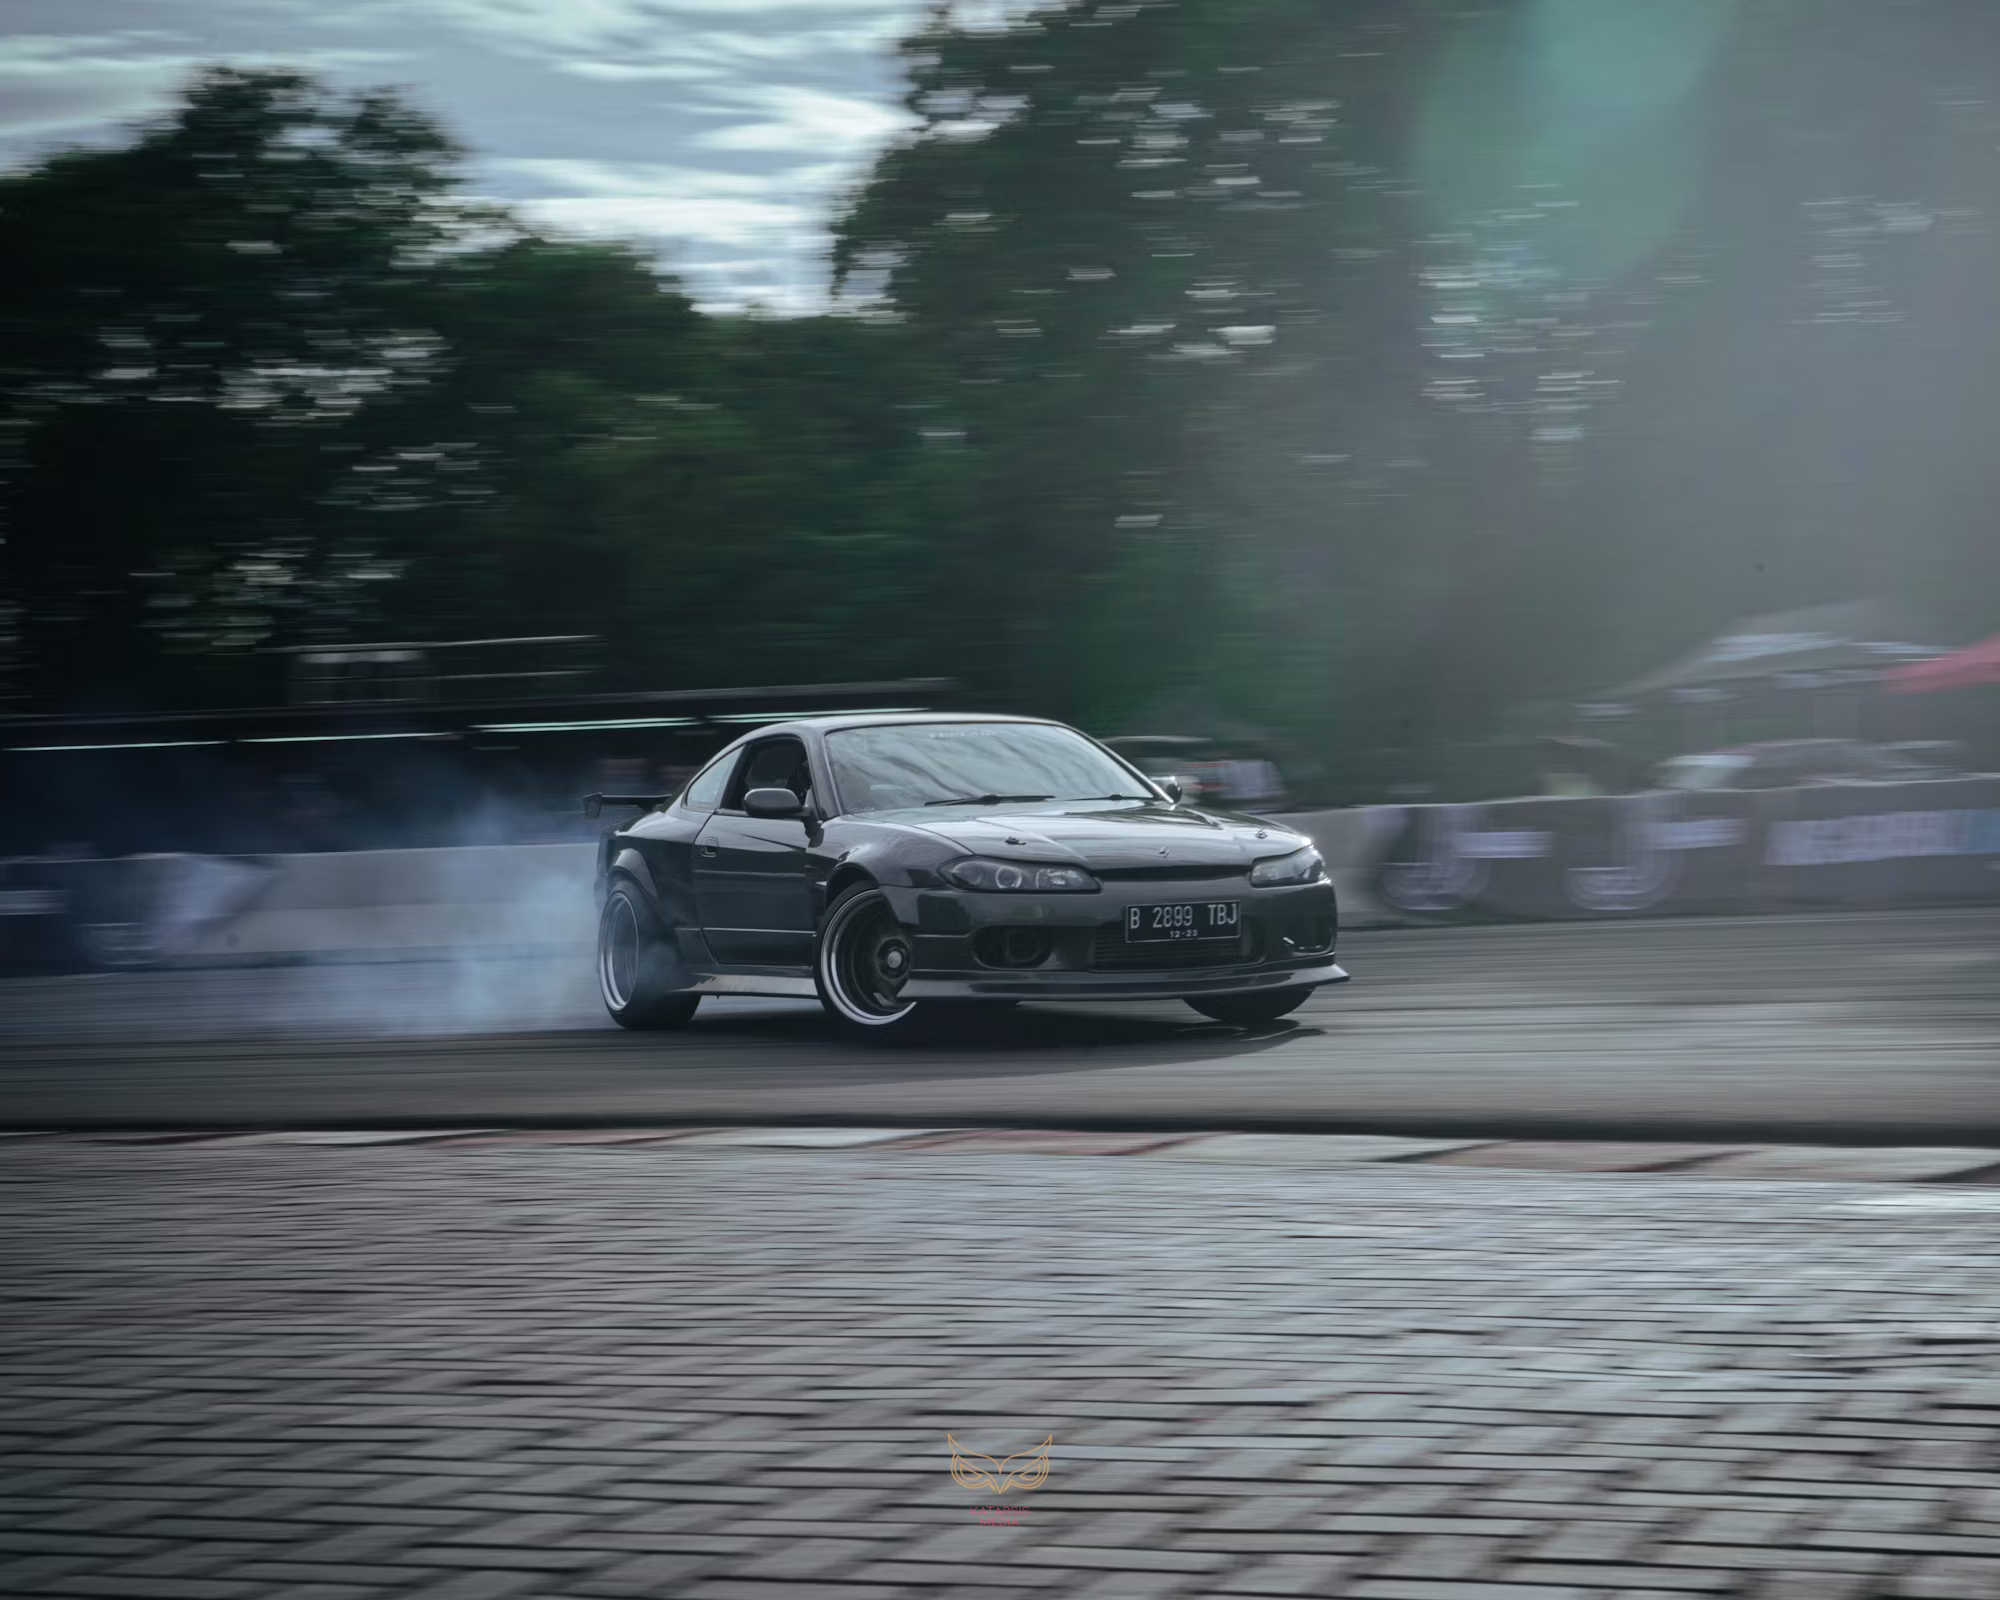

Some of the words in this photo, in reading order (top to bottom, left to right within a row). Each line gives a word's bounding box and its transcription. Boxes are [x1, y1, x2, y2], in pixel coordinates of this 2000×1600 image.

[1130, 907, 1141, 929] B
[1152, 905, 1193, 928] 2899
[1207, 903, 1237, 925] TBJ
